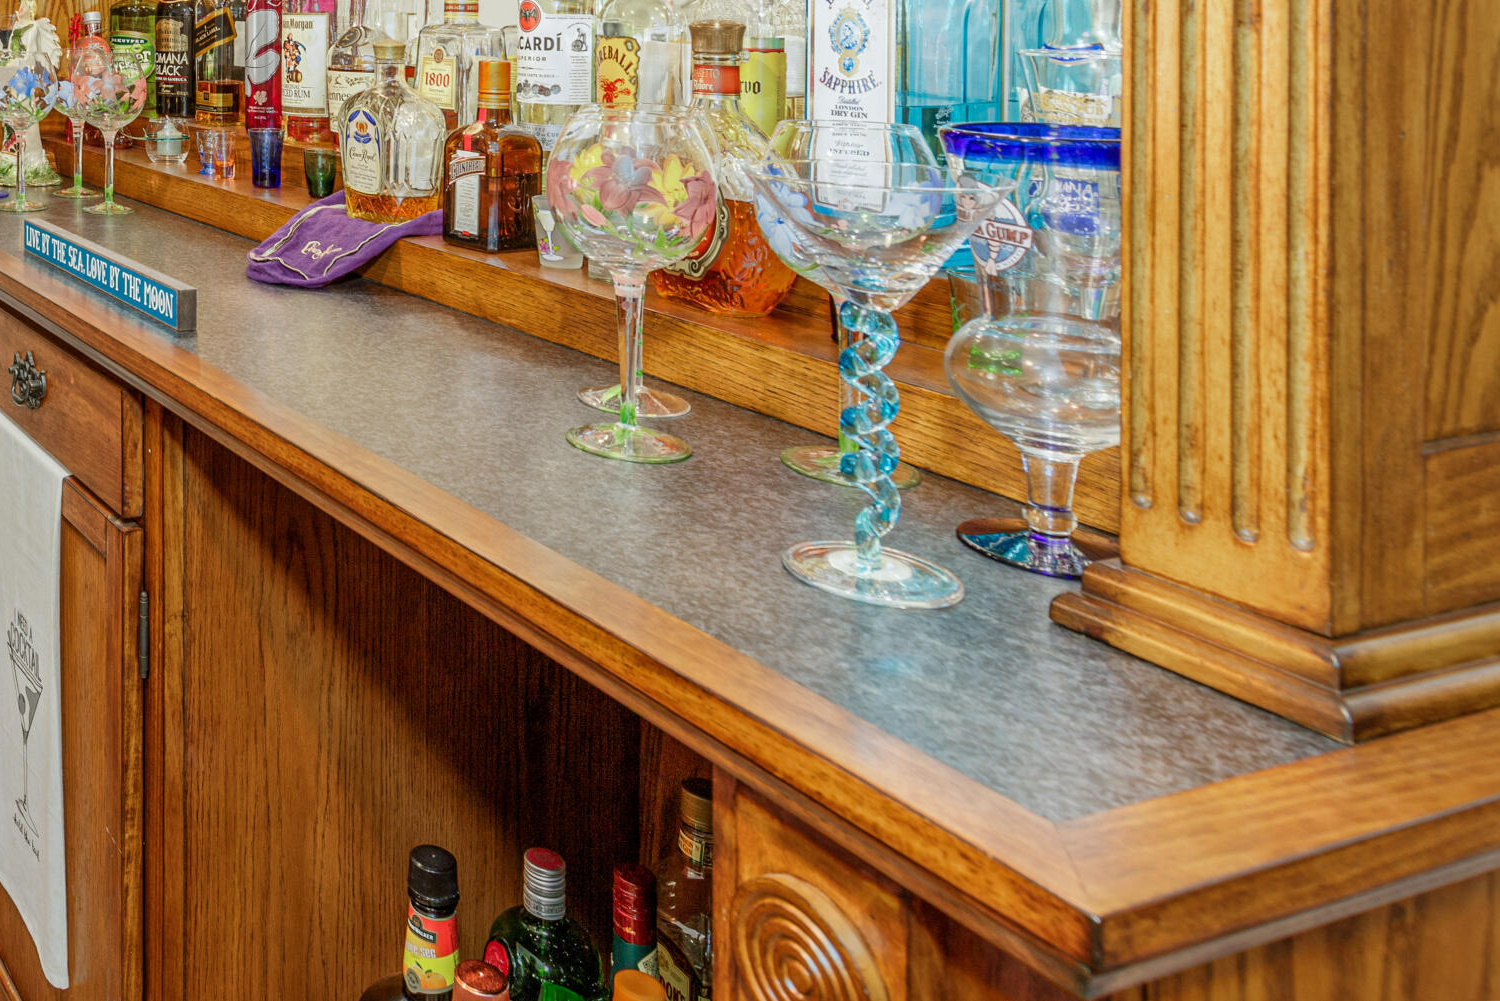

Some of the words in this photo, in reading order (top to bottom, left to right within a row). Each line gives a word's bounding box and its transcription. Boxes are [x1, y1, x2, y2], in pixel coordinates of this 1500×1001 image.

[290, 18, 313, 31] Morgan
[425, 72, 450, 88] 1800
[820, 67, 879, 94] SAPPHIRE
[830, 109, 849, 117] DRY
[850, 110, 868, 119] GIN
[986, 223, 1029, 244] GUMP
[26, 225, 40, 251] LIVE
[42, 232, 50, 256] BY
[52, 238, 66, 264] THE
[86, 254, 107, 285] LOVE
[110, 266, 121, 291] BY
[122, 272, 141, 302] THE
[144, 281, 174, 319] MOON
